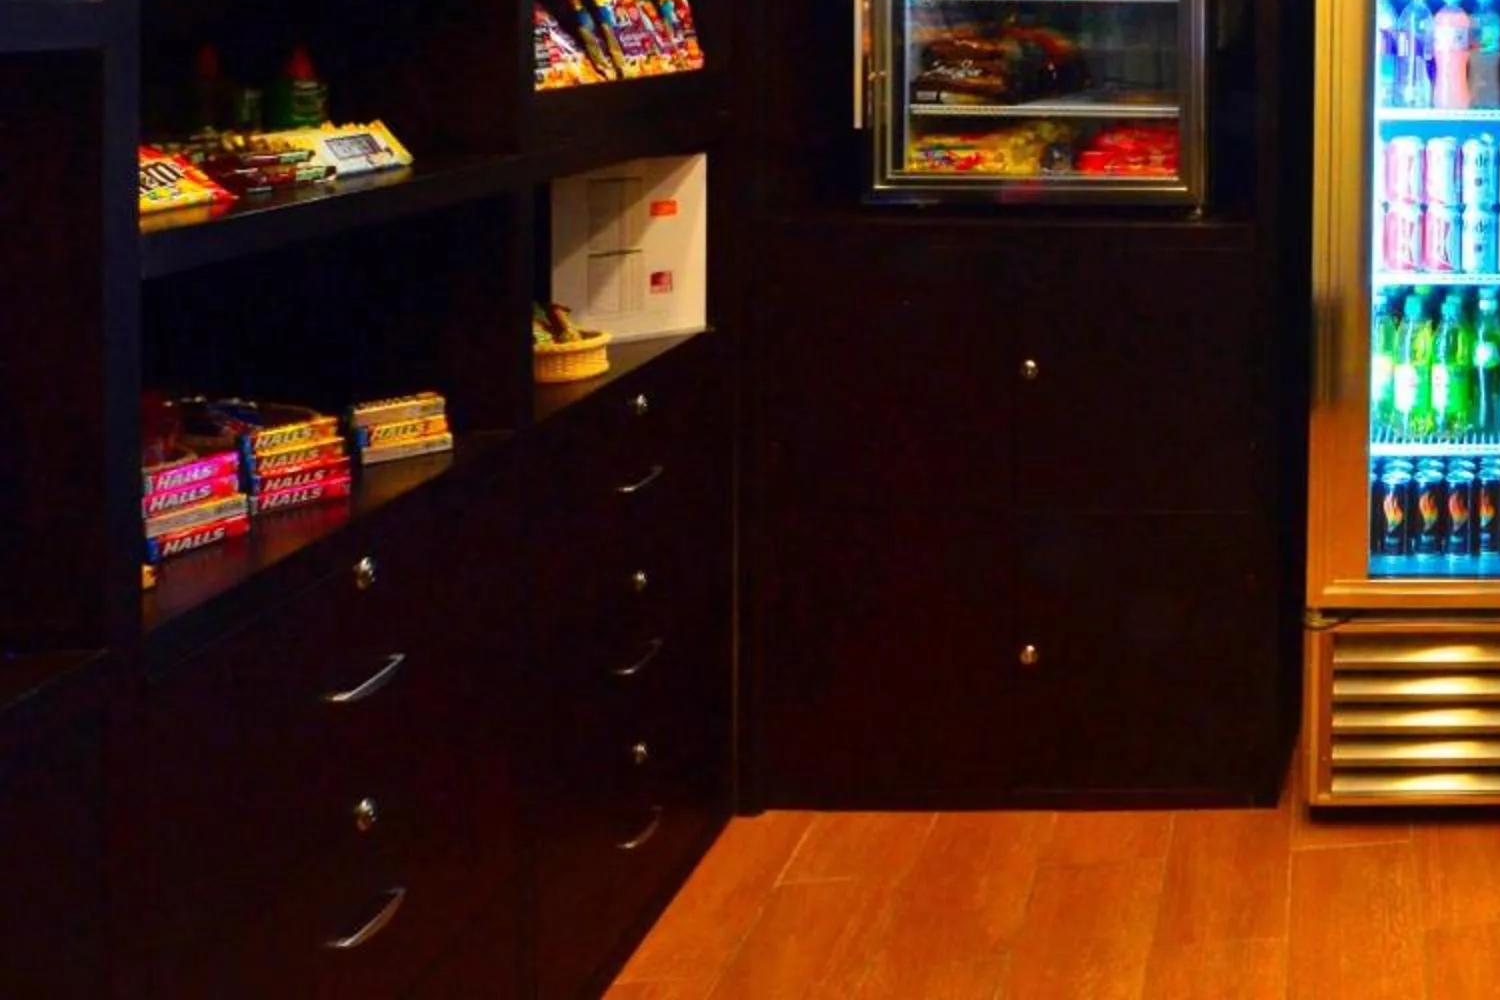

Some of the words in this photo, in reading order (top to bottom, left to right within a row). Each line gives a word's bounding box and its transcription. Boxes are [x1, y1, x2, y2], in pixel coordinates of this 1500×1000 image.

[255, 427, 313, 449] HALLS
[263, 469, 327, 493] HALLS
[149, 484, 212, 512] HALLS
[261, 487, 323, 510] HALLS
[162, 527, 226, 557] HALLS
